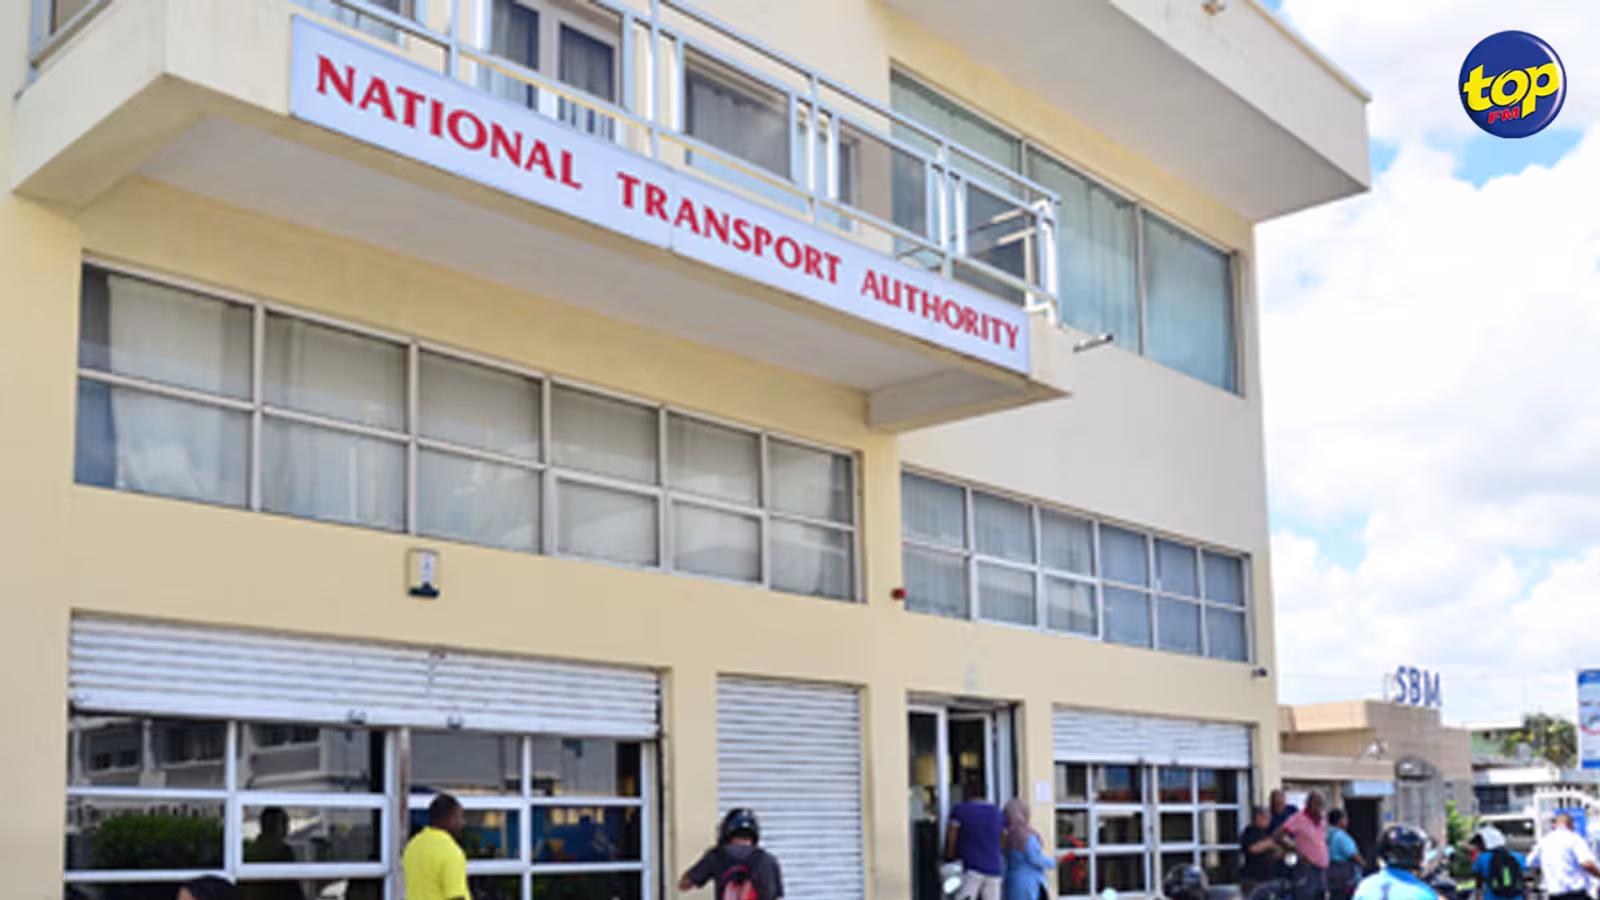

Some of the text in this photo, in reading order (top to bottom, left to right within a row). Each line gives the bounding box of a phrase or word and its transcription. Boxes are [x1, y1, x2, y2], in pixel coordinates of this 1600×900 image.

[316, 54, 1020, 350] NATIONAL TRANSPORT AUTHORITY
[1396, 665, 1442, 706] SBM
